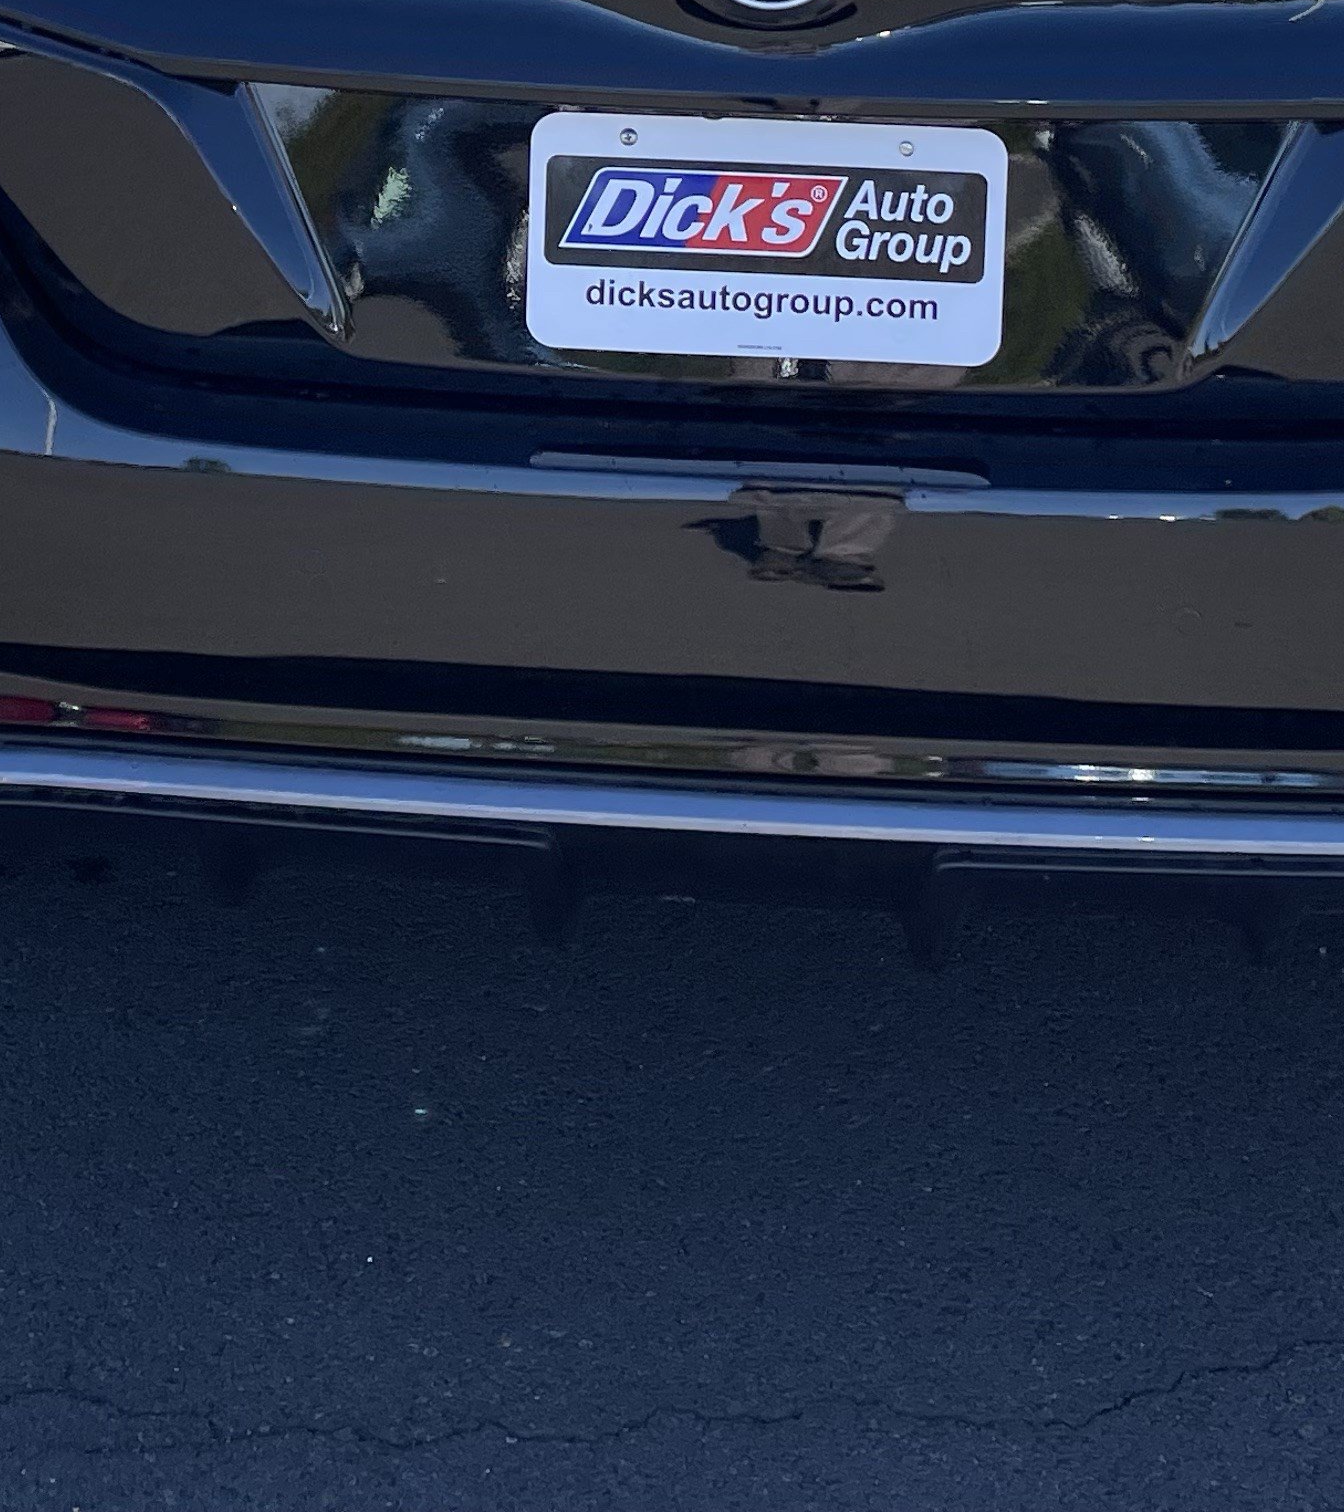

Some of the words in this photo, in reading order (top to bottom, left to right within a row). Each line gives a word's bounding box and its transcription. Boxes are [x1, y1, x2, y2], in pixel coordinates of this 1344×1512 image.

[581, 178, 814, 245] Dick's
[843, 179, 954, 224] Auto
[836, 219, 972, 274] Group
[585, 279, 939, 322] dicksautogroup.com
